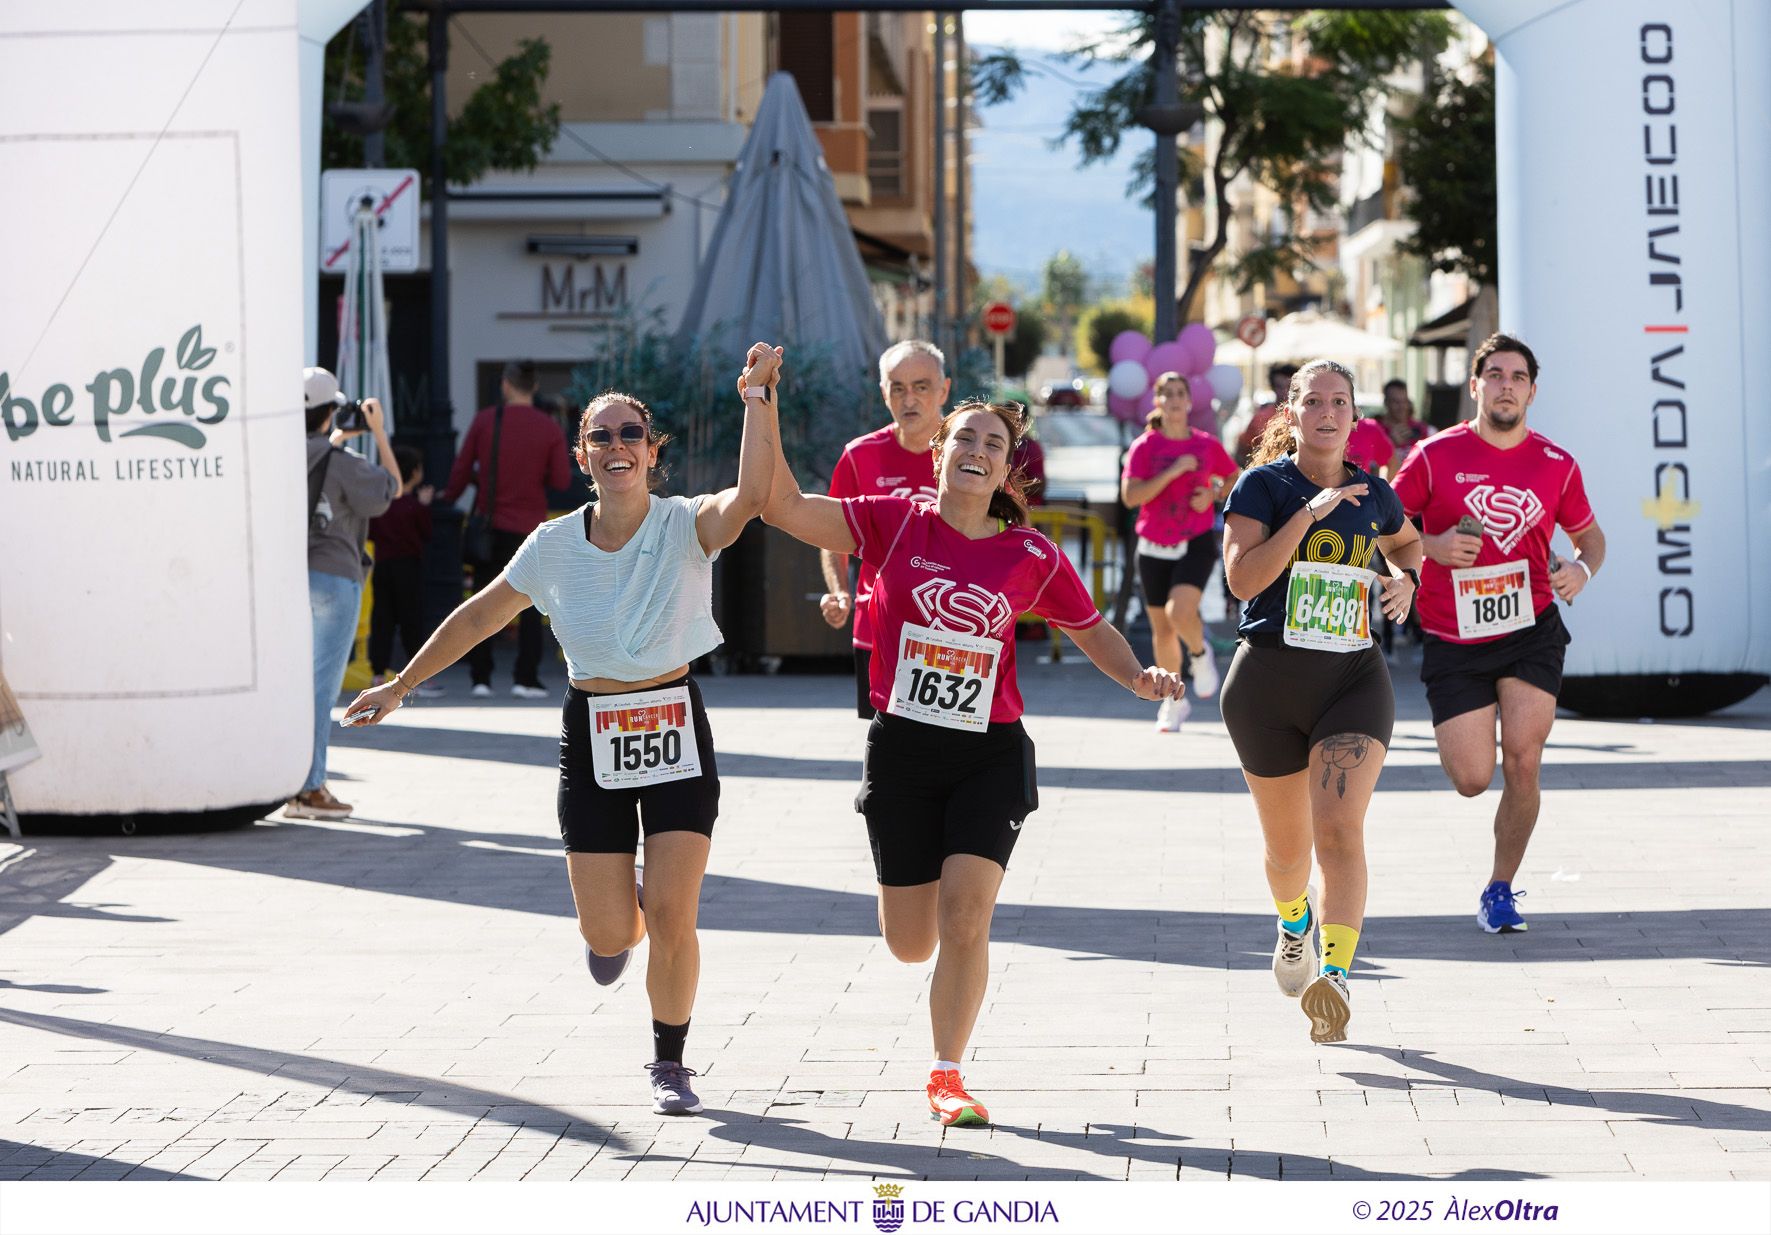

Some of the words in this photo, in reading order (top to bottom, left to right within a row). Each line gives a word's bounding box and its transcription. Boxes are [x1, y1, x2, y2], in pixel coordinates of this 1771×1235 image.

[1640, 23, 1683, 313] JAECOO
[542, 264, 627, 312] MrM
[0, 371, 75, 442] be
[85, 346, 231, 443] plus
[11, 461, 100, 481] NATURAL
[116, 456, 223, 480] LIFESTYLE
[1295, 593, 1364, 631] 64981
[1472, 590, 1519, 625] 1801
[907, 667, 982, 714] 1632
[610, 729, 682, 772] 1550
